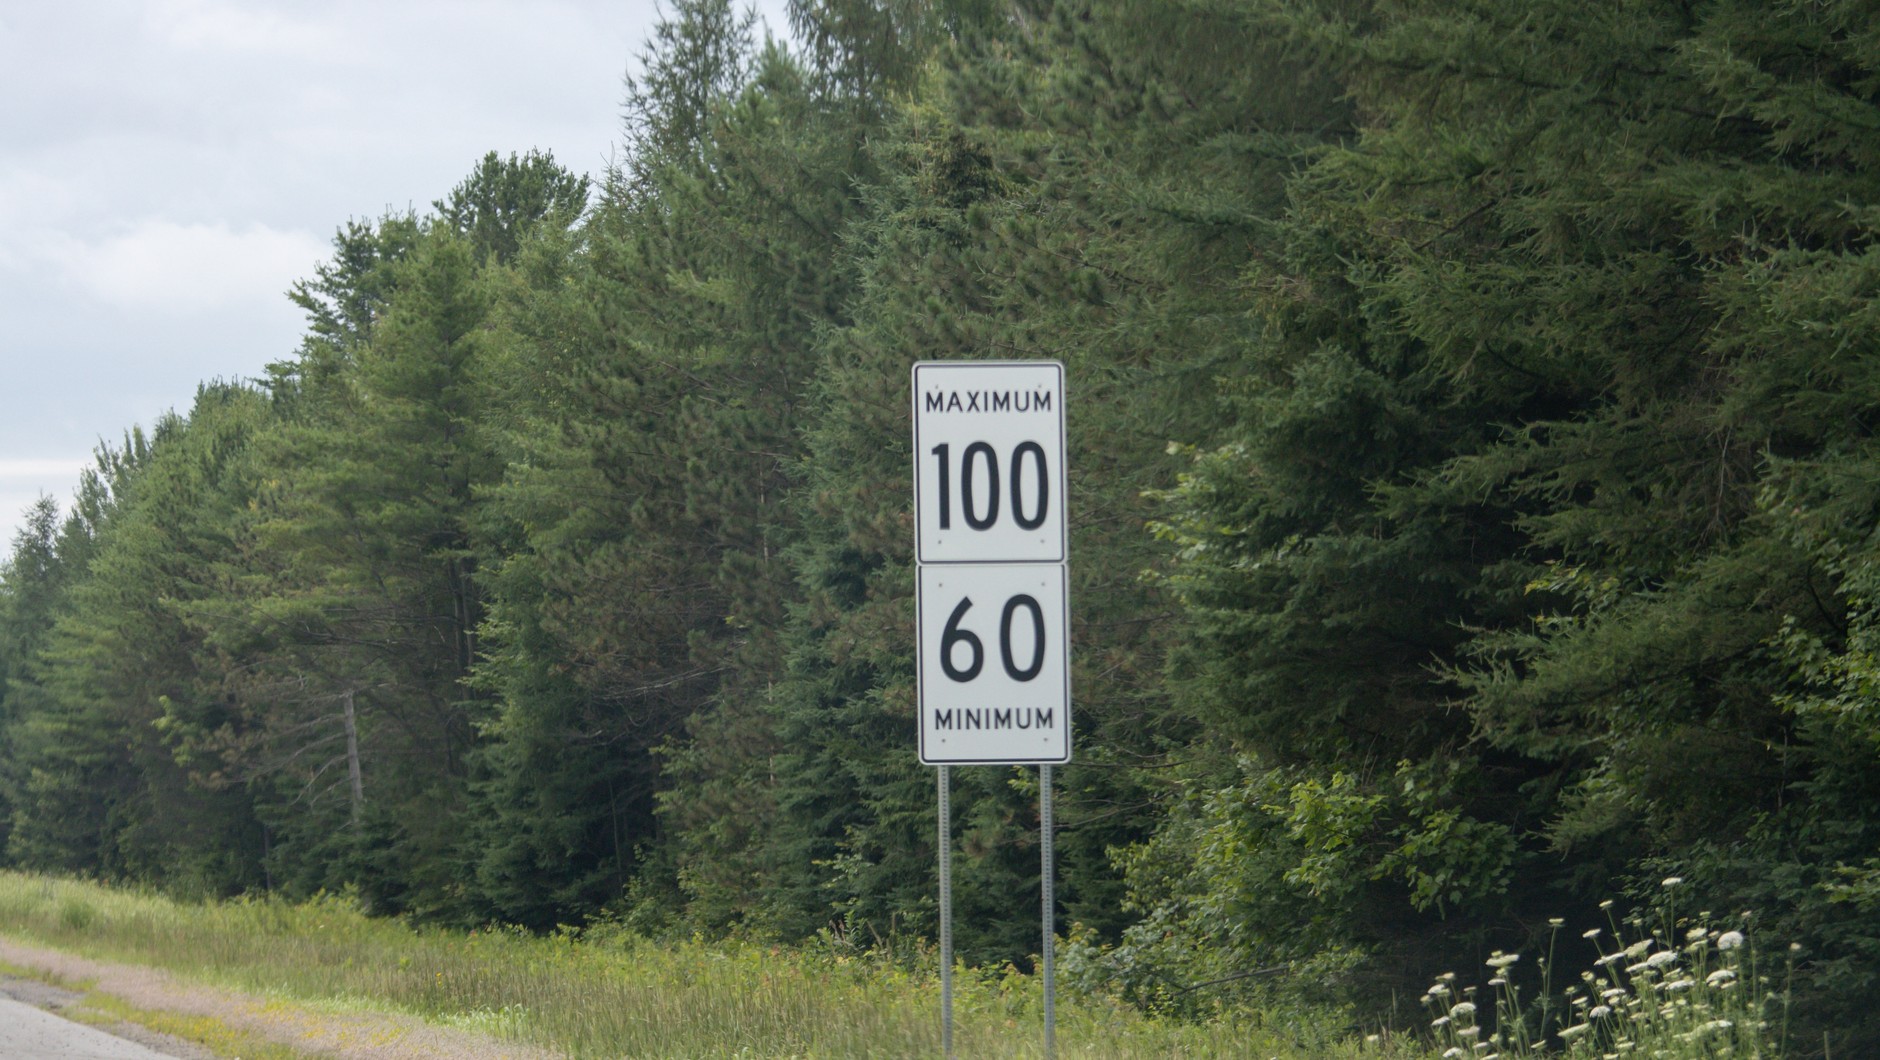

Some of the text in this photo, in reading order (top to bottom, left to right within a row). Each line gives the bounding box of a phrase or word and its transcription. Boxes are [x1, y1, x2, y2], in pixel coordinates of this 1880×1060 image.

[926, 390, 1052, 413] MAXIMUM
[931, 440, 1049, 532] 100
[939, 593, 1046, 684] 60
[935, 707, 1053, 731] MINIMUM
